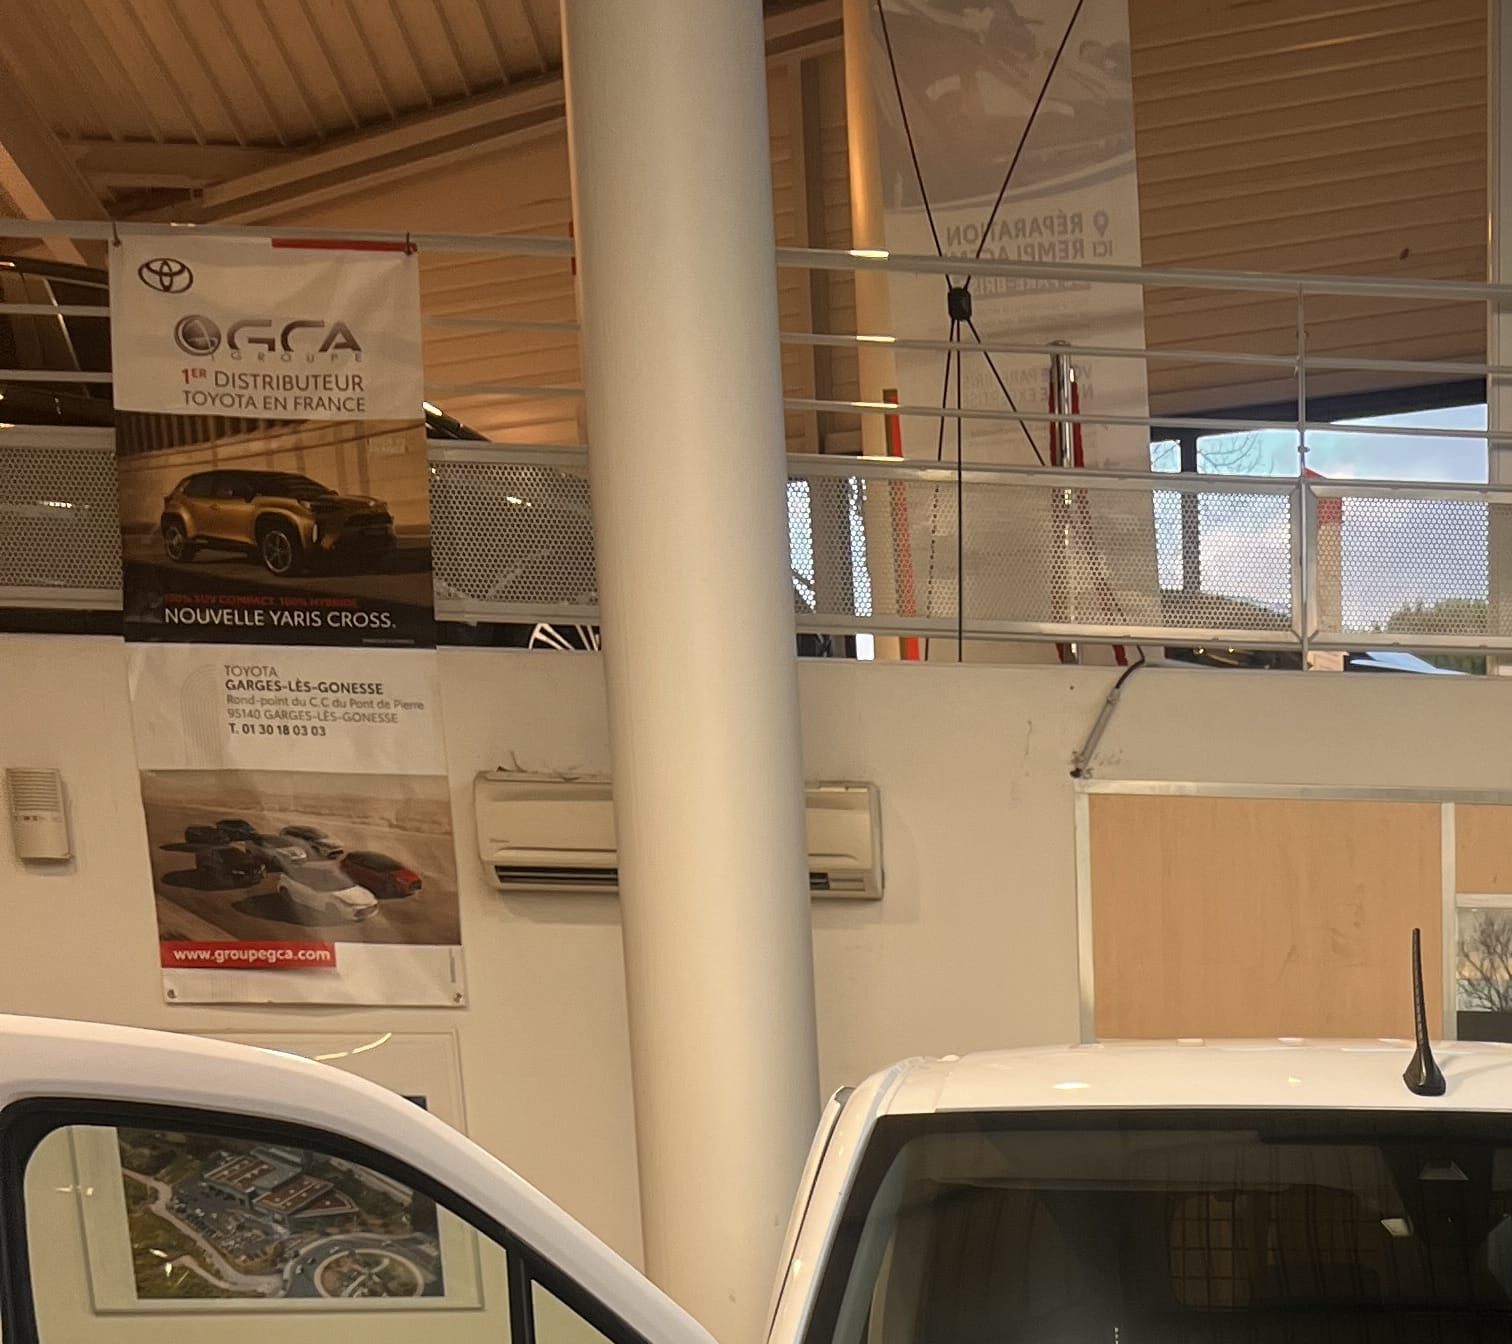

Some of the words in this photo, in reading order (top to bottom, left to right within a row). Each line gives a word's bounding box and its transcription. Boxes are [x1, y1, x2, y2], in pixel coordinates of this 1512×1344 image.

[231, 351, 362, 363] GROUPE
[214, 370, 364, 392] DISTRIBUTEUR
[182, 390, 259, 410] TOYOTA
[263, 396, 287, 410] EN
[294, 396, 366, 412] FRANCE
[165, 607, 265, 626] NOUVELLE
[269, 610, 321, 627] YARIS
[327, 611, 396, 629] CROSS.
[224, 665, 278, 678] TOYOTA
[225, 678, 384, 695] GARGES-LÈS-GONESSE
[226, 695, 289, 708] Rond-point
[292, 696, 306, 707] du
[332, 698, 347, 709] du
[350, 699, 374, 710] Pont
[377, 699, 391, 710] de
[394, 700, 424, 711] Pierre
[228, 708, 260, 720] 95140
[264, 708, 398, 724] GARGES-LÈS-GONESSE
[242, 724, 255, 735] 01
[259, 724, 274, 735] 30
[277, 724, 290, 736] 18
[294, 725, 308, 736] 03
[311, 726, 326, 737] 03
[173, 949, 331, 964] www.groupegca.com
